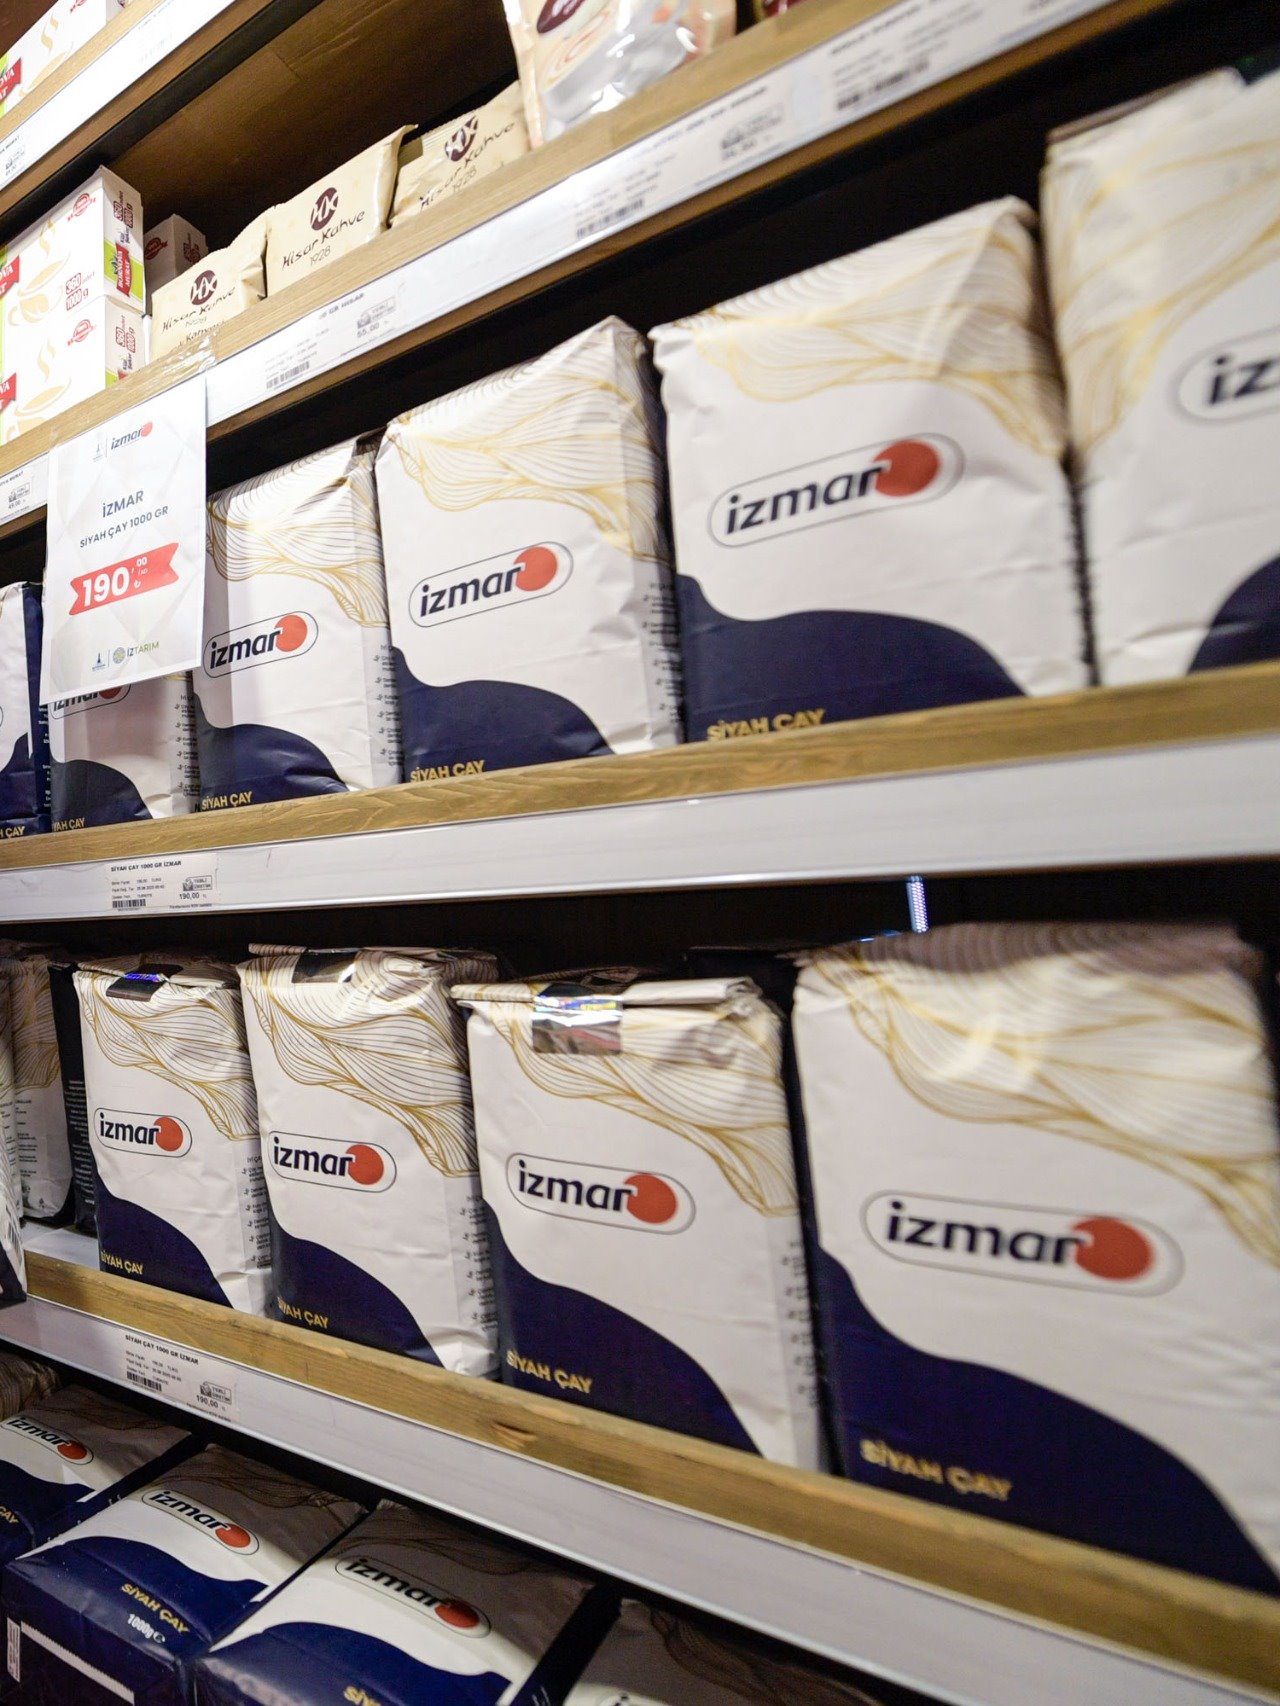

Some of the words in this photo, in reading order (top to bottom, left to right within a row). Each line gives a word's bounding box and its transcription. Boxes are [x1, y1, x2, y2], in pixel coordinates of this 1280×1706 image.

[282, 239, 318, 271] Hisar
[321, 211, 365, 244] Kahve
[102, 490, 144, 518] İZMAR
[726, 462, 885, 535] izmar
[108, 522, 128, 539] ÇAY
[130, 512, 152, 528] 1000
[154, 506, 168, 518] GR
[420, 566, 522, 617] izmar
[210, 626, 281, 669] izmar
[410, 766, 449, 782] SİYAH
[201, 794, 228, 810] SİYAH
[229, 791, 252, 808] ÇAY
[5, 826, 25, 840] ÇAY
[70, 818, 85, 830] ÇAY
[179, 892, 199, 900] 190,00
[99, 1112, 159, 1145] izmar
[274, 1136, 355, 1177] izmar
[519, 1160, 634, 1213] izmar
[888, 1201, 1084, 1265] izmar
[100, 1250, 123, 1271] SİYAH
[124, 1256, 143, 1276] ÇAY
[277, 1295, 301, 1320] SİYAH
[303, 1308, 329, 1330] ÇAY
[143, 1341, 154, 1349] ÇAY
[156, 1345, 169, 1354] 1000
[507, 1350, 551, 1380] SİYAH
[554, 1368, 594, 1394] ÇAY
[7, 1416, 69, 1449] izmar
[860, 1437, 944, 1484] SİYAH
[948, 1467, 1012, 1500] ÇAY
[149, 1490, 231, 1532] izmar
[344, 1558, 450, 1610] izmar
[121, 1583, 161, 1611] SİYAH
[159, 1609, 190, 1633] ÇAY
